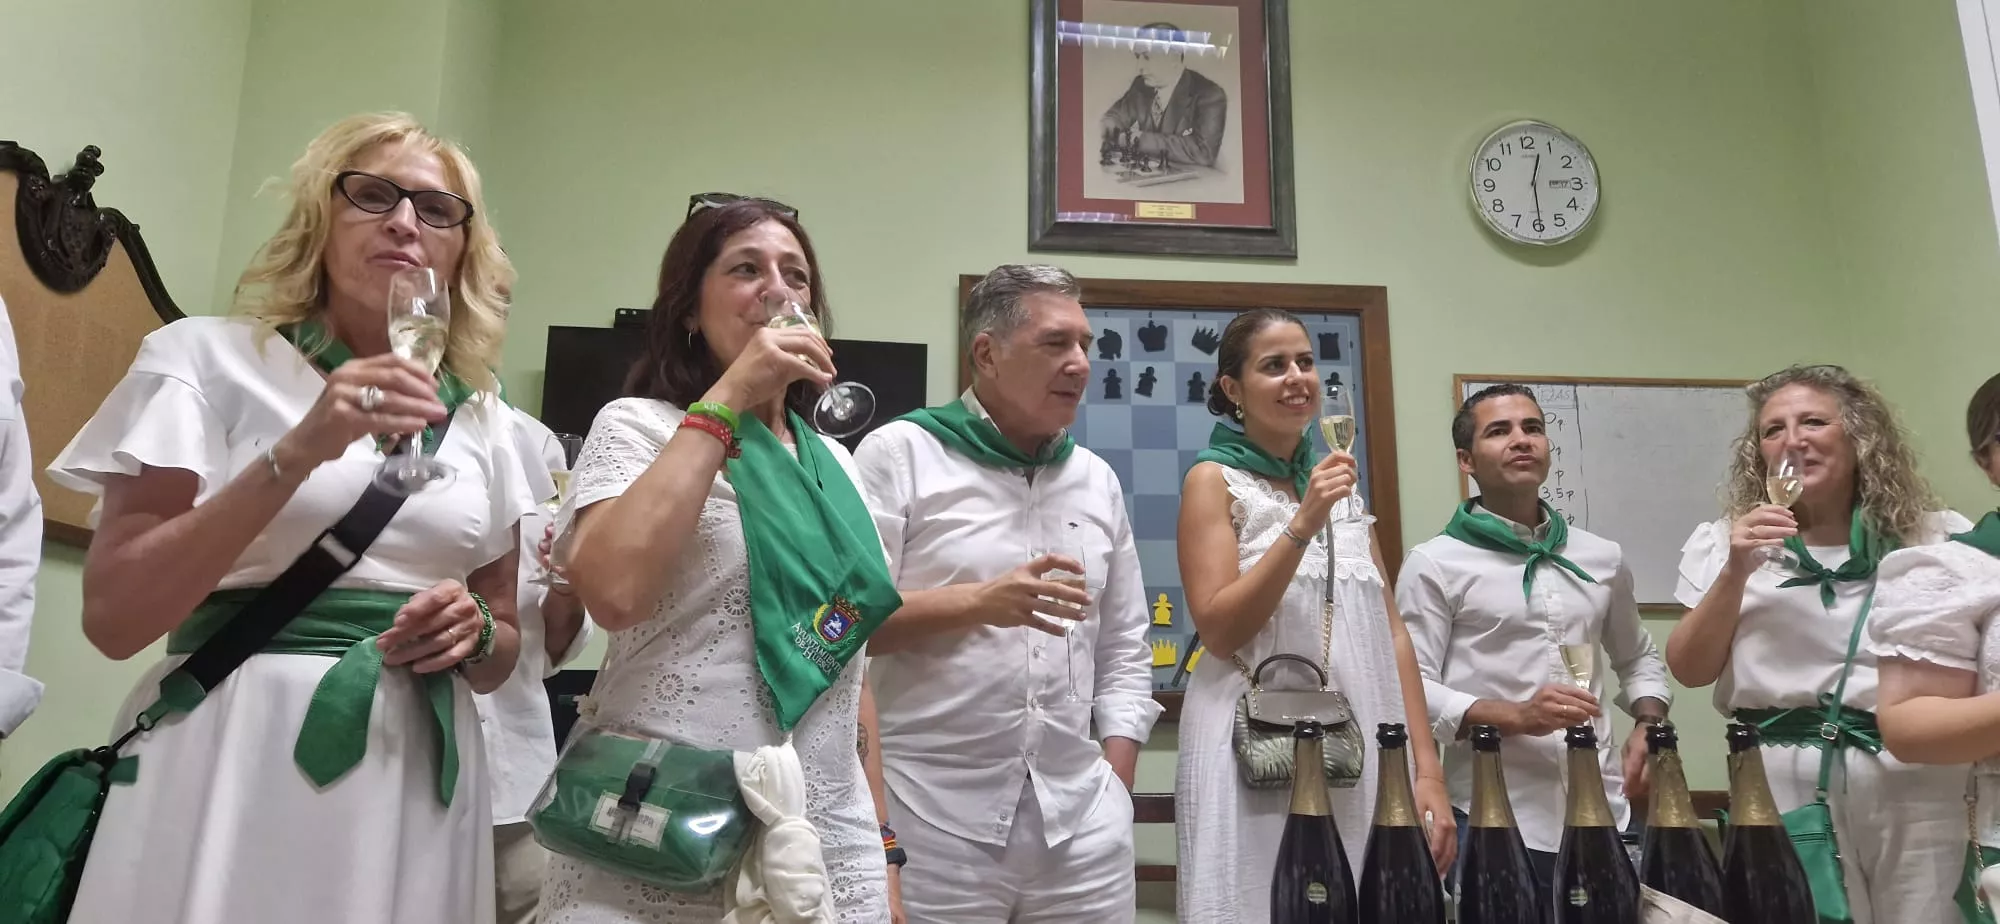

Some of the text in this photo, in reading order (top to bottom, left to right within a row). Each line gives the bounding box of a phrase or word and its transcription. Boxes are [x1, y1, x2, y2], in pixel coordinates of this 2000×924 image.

[1500, 142, 1511, 155] 11
[1520, 136, 1535, 149] 12
[1547, 141, 1552, 155] 1
[1486, 158, 1501, 171] 10
[1561, 155, 1573, 168] 2
[1483, 178, 1495, 192] 9
[1571, 177, 1583, 190] 3
[1492, 198, 1504, 212] 8
[1566, 197, 1579, 211] 4
[1511, 214, 1521, 228] 7
[1532, 219, 1545, 232] 6
[1553, 213, 1566, 227] 5
[795, 635, 832, 676] DE HUESCA
